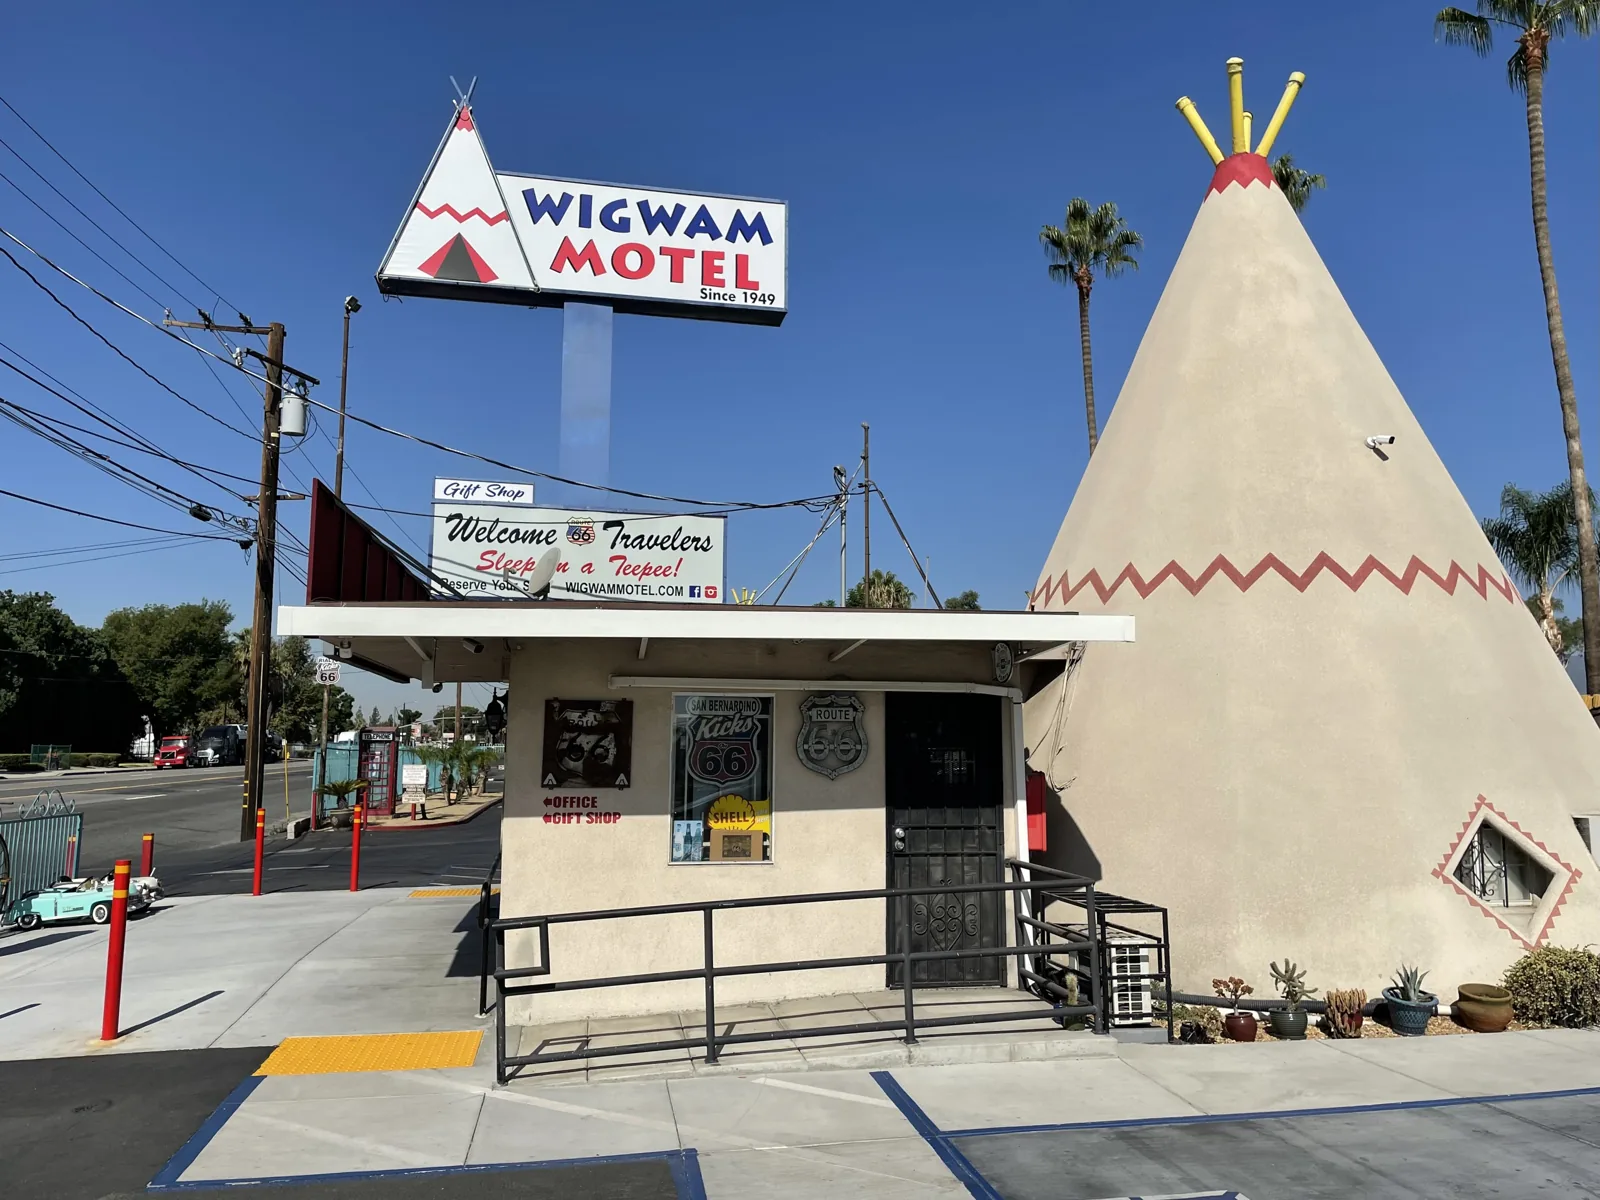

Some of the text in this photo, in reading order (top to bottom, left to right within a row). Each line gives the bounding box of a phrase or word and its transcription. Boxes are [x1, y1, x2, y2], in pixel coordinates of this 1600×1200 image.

[521, 187, 774, 246] WIGWAM
[549, 235, 760, 291] MOTEL
[700, 286, 776, 306] Since 1949
[443, 482, 525, 501] Gift Shop
[445, 512, 558, 546] Welcome
[571, 526, 591, 541] 66
[603, 520, 713, 552] Travelers
[475, 549, 536, 578] Sleep
[580, 561, 595, 575] a
[608, 554, 684, 582] Teepee!
[565, 582, 684, 597] WIGWAMMOTEL.COM
[320, 672, 336, 682] 66
[691, 699, 757, 712] SAN BERNARDINO
[816, 709, 850, 720] ROUTE
[695, 712, 753, 740] Kicks
[808, 723, 856, 762] 66
[697, 745, 749, 777] 66
[552, 796, 598, 808] OFFICE
[552, 811, 622, 824] GIFT SHOP
[713, 811, 750, 824] SHELL
